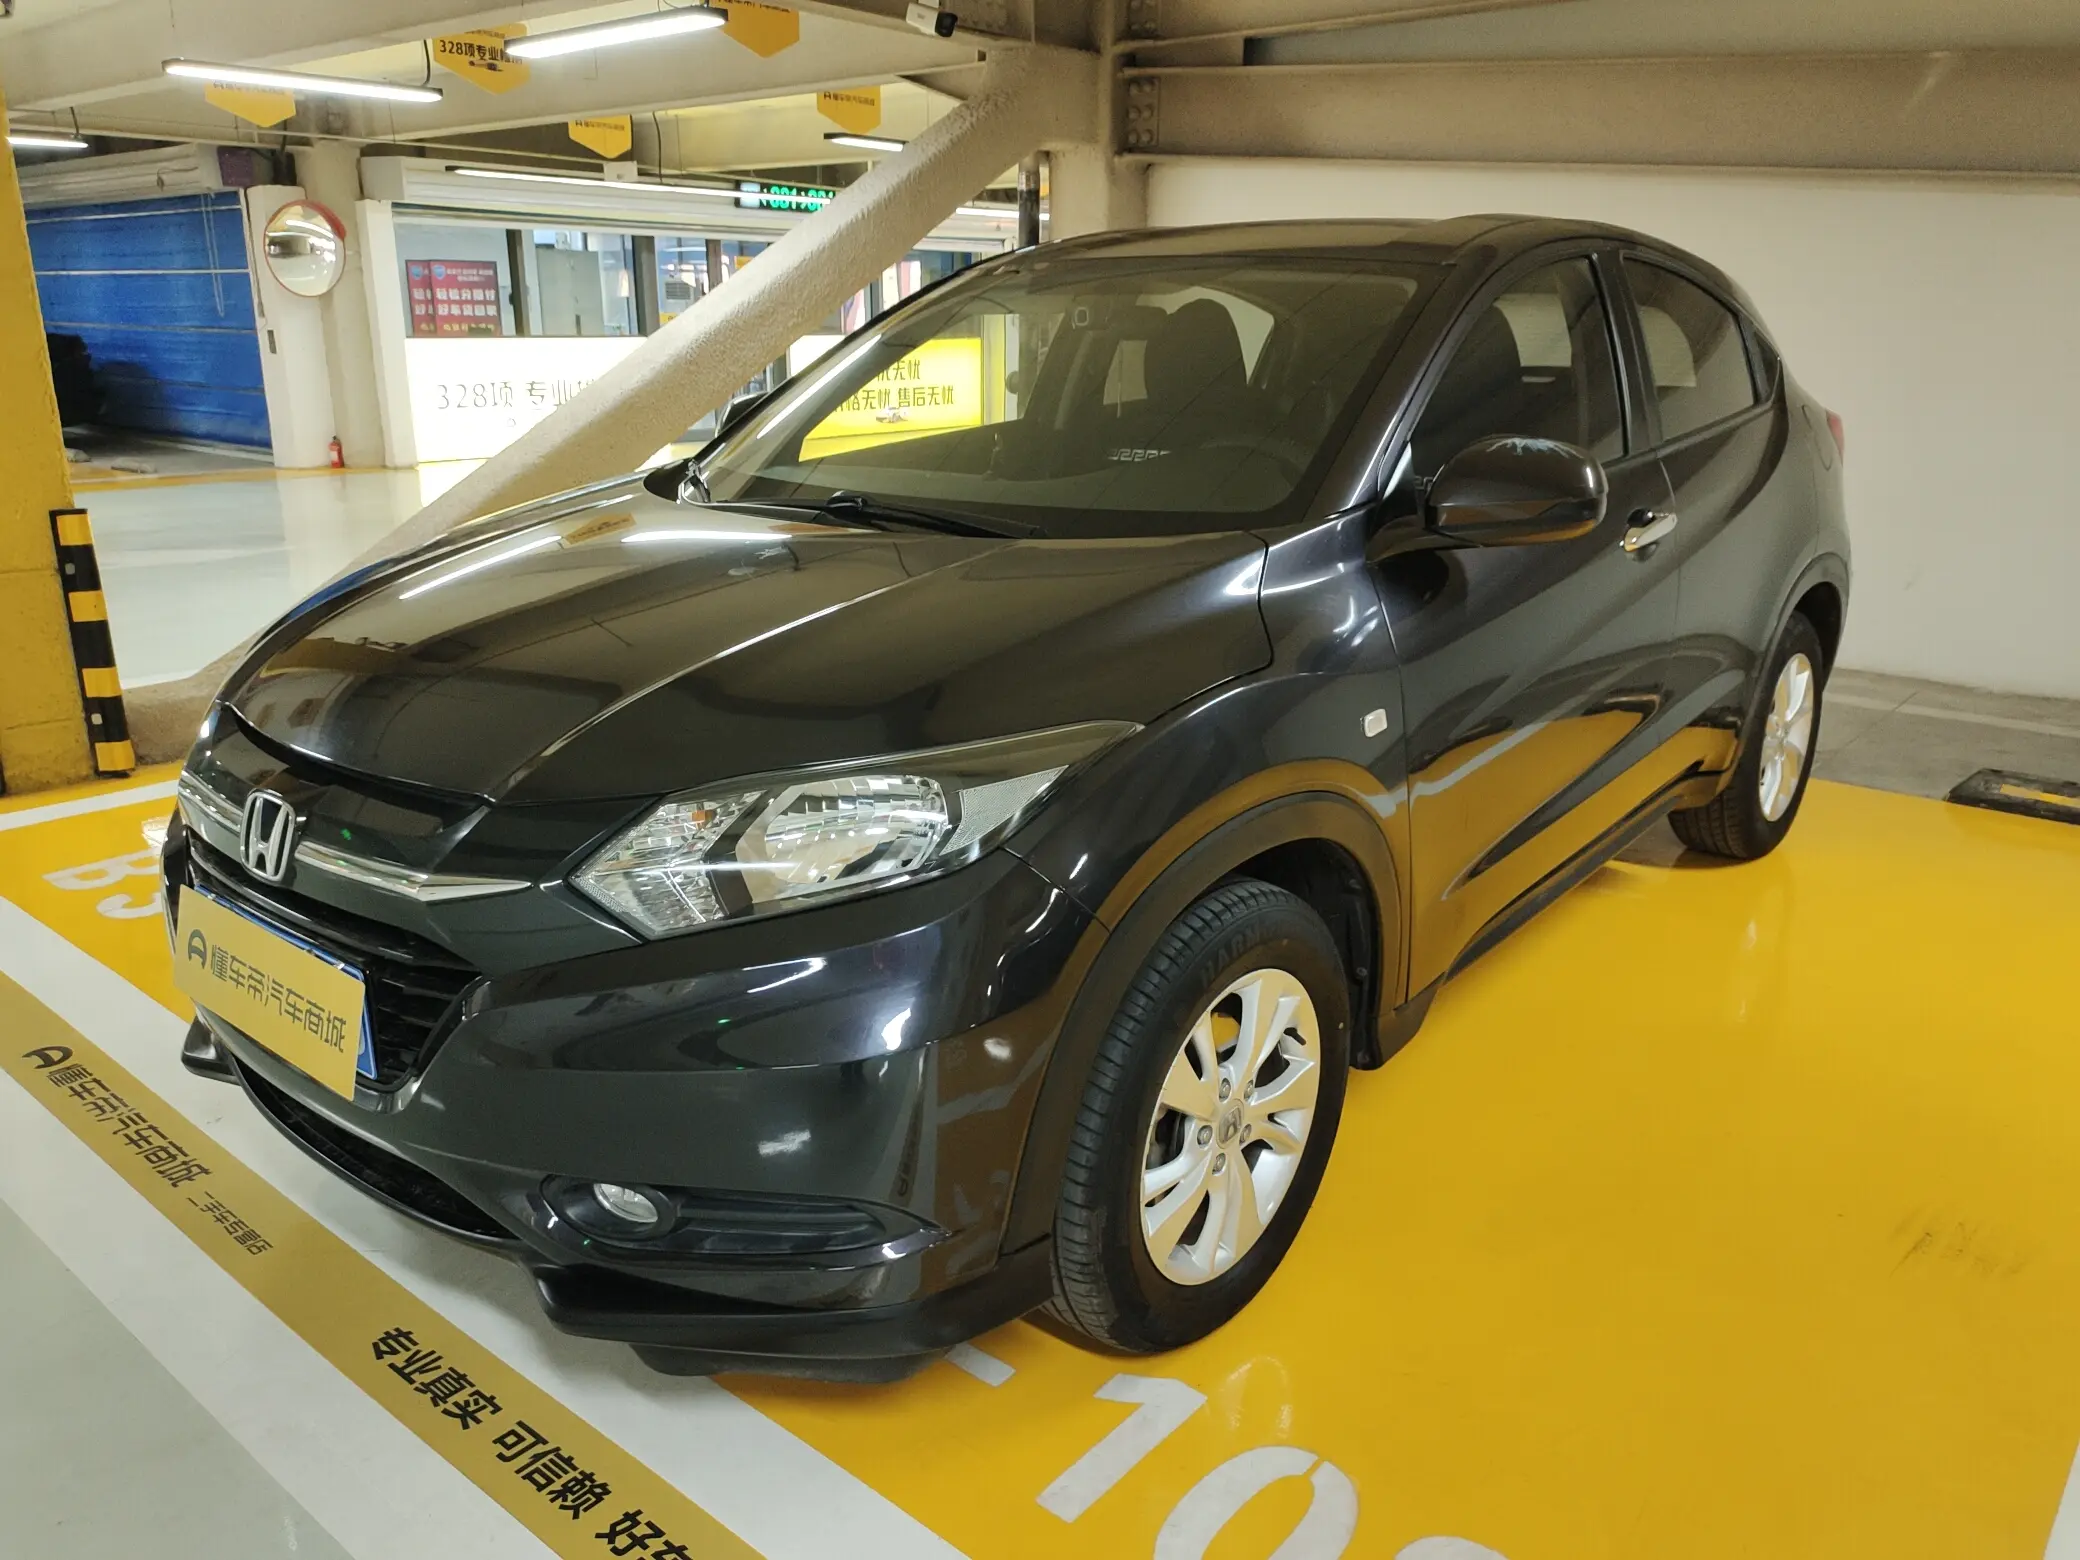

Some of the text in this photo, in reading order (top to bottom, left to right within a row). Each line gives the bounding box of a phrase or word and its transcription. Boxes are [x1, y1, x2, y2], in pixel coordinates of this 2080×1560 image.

[437, 381, 513, 410] 328项
[898, 385, 954, 408] 售后无忧
[210, 944, 348, 1054] 懂车帝汽车商城
[46, 1062, 274, 1257] 懂车帝汽车商城 二手车专营店
[371, 1326, 503, 1431] 专业真实
[491, 1419, 613, 1521] 可信赖
